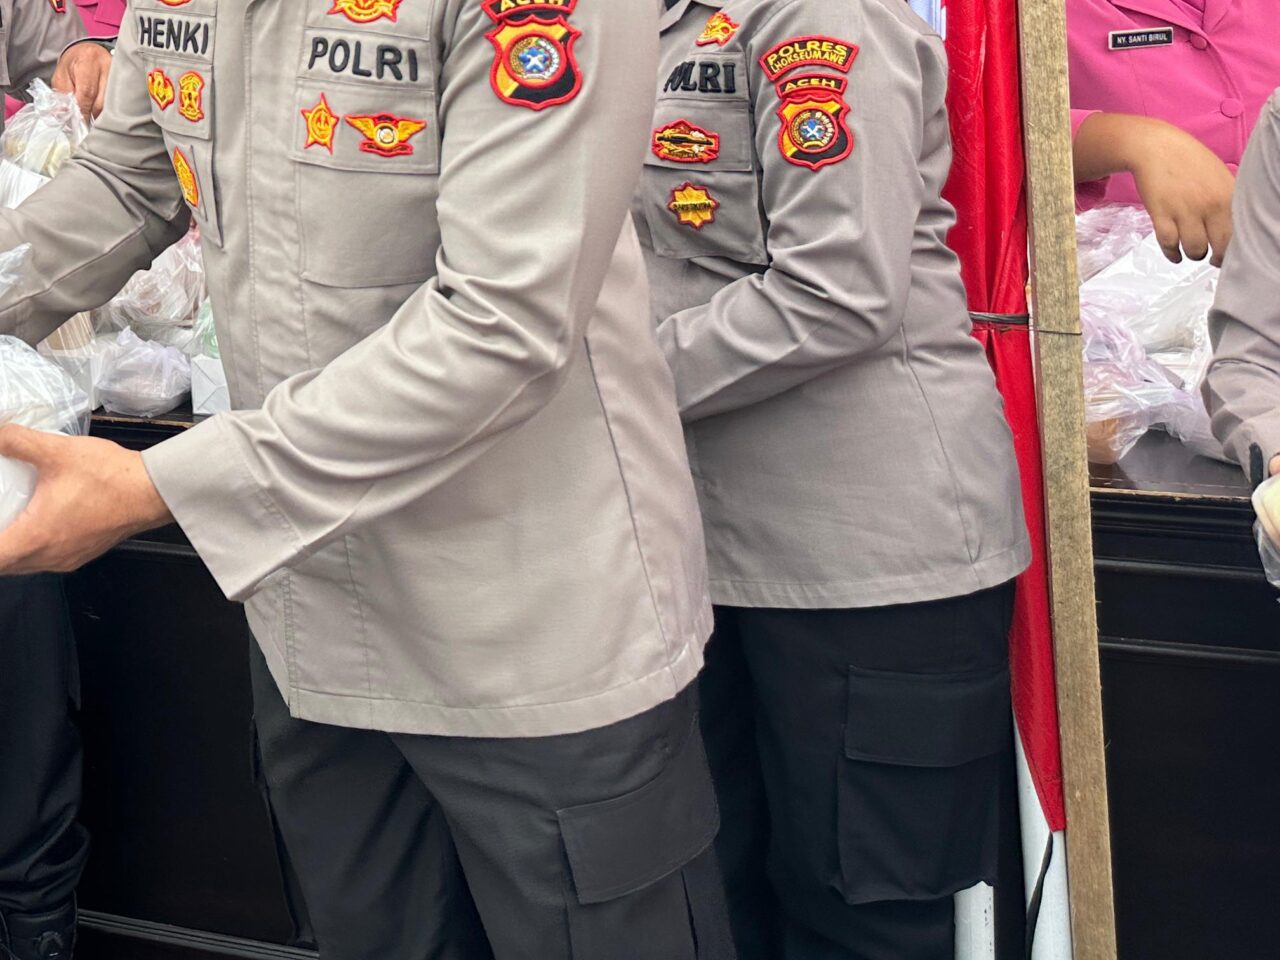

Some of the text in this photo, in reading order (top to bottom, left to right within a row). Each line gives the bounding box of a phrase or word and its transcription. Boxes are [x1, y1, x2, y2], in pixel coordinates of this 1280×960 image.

[139, 16, 210, 55] HENKI
[308, 36, 419, 82] POLRI
[767, 40, 847, 66] POLRES
[770, 50, 846, 73] LHOKSEUMAWE
[784, 78, 835, 92] ACEH
